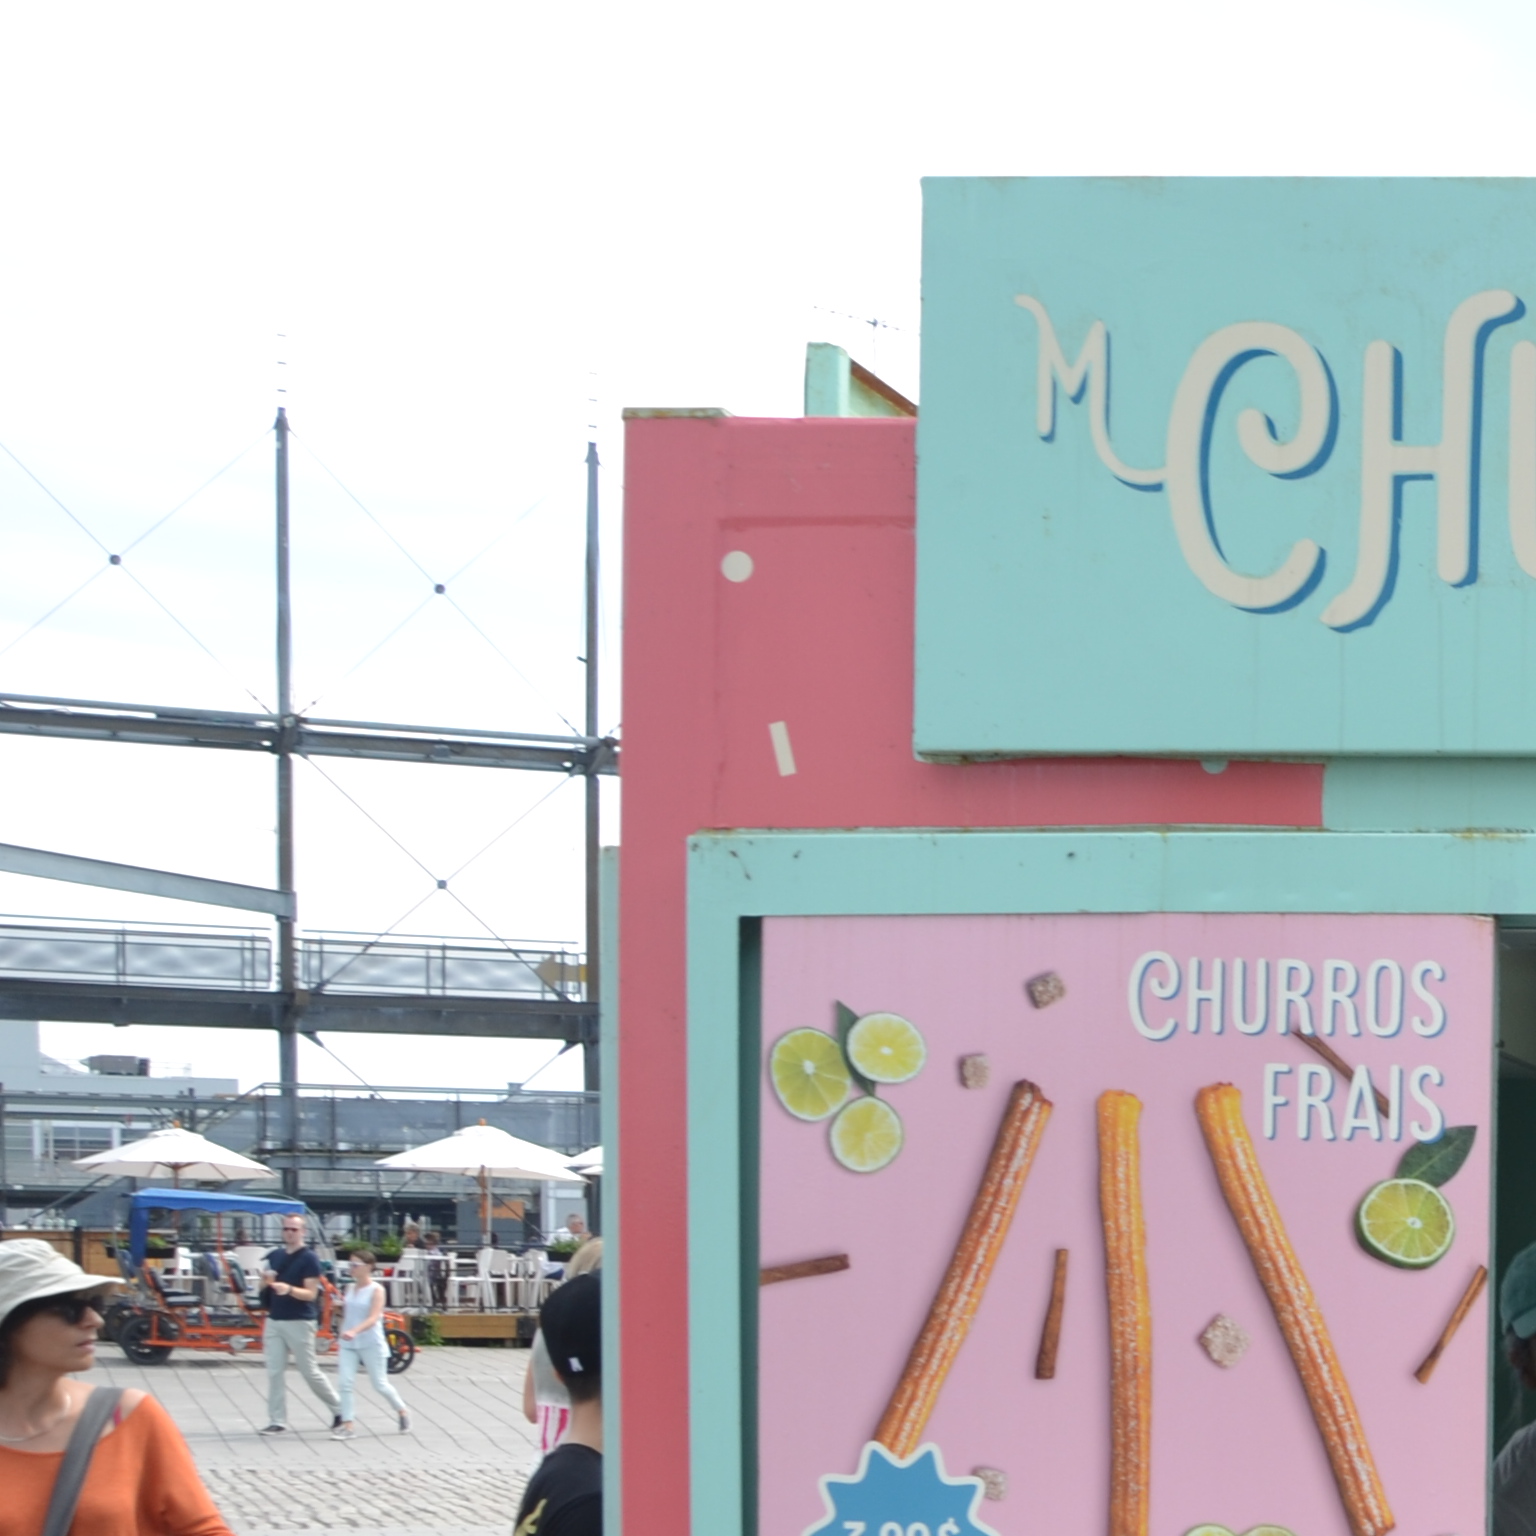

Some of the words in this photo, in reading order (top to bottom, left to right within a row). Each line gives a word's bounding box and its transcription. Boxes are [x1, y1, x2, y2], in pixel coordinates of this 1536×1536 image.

[1014, 293, 1164, 492] M
[1127, 950, 1448, 1041] CHURROS
[1262, 1062, 1446, 1143] FRAIS
